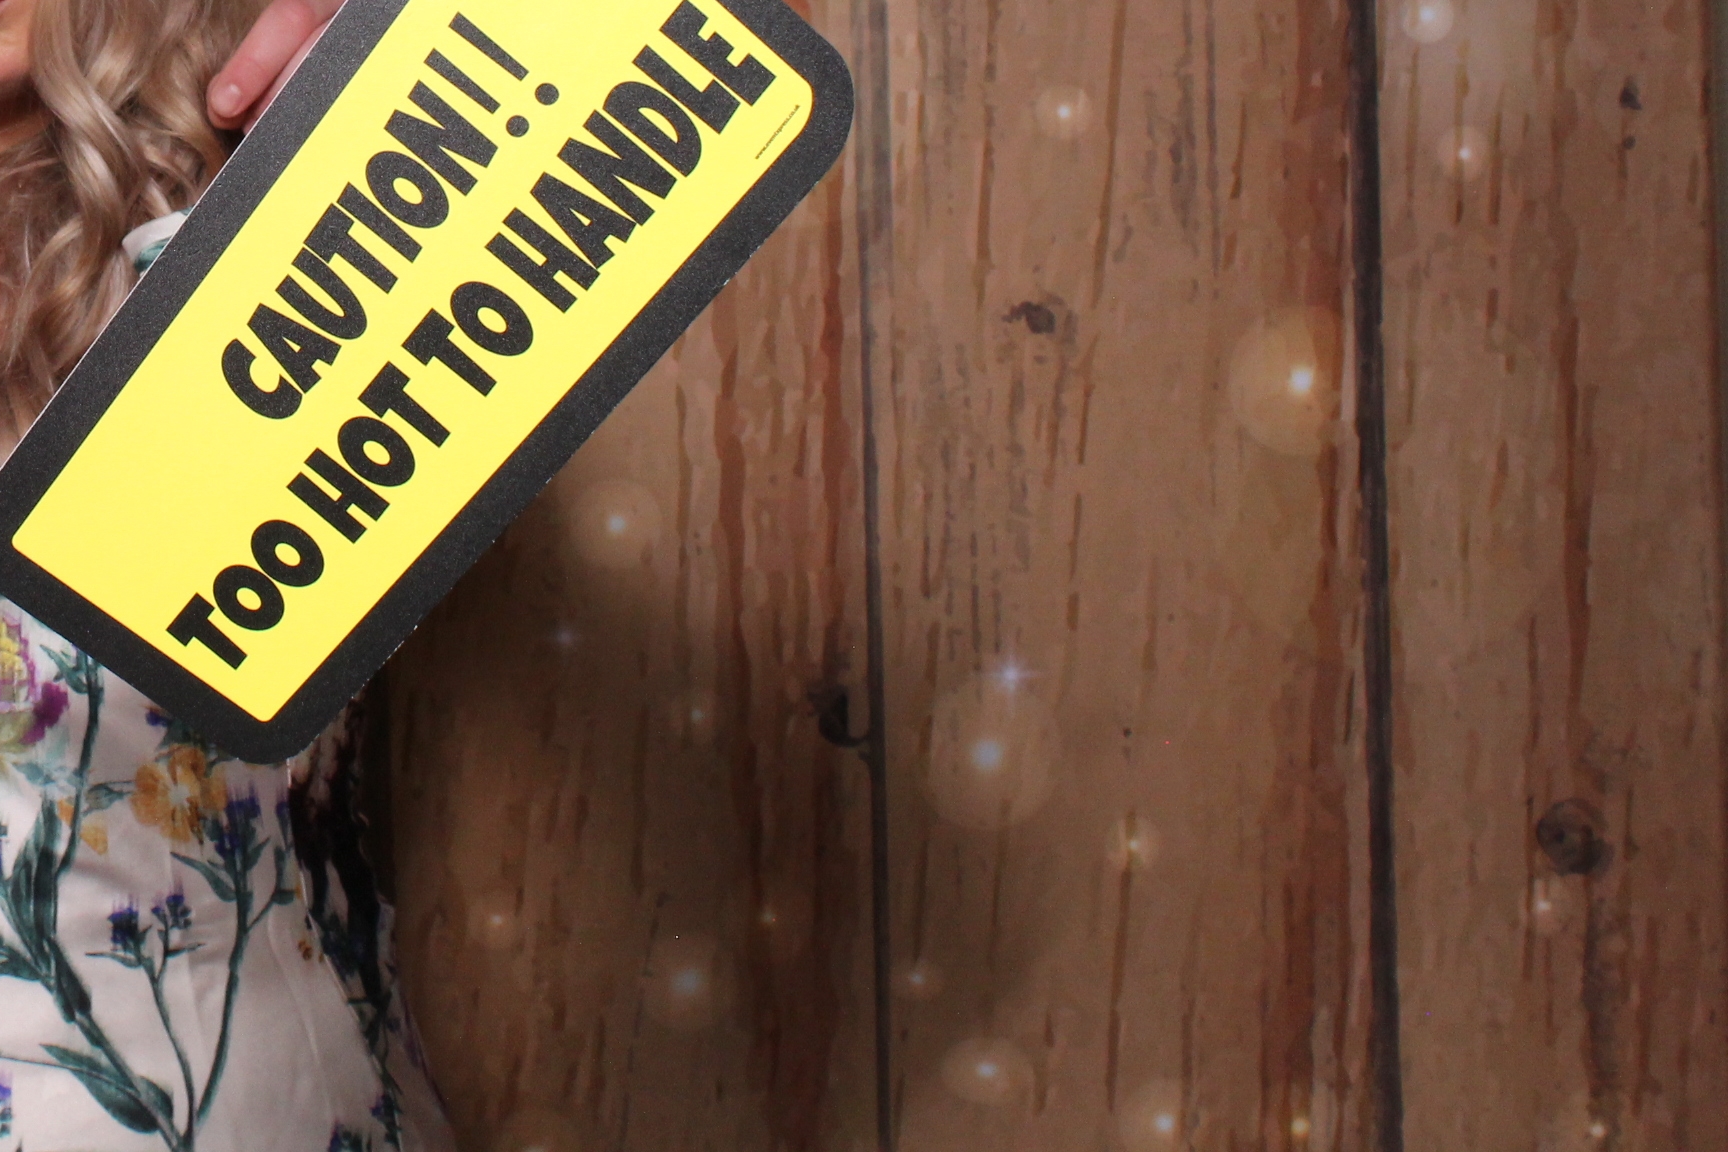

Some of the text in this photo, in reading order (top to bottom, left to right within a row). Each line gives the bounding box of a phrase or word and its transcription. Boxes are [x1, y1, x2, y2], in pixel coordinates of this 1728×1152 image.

[166, 0, 776, 671] TOO HOT TO HANDLE
[221, 13, 560, 420] CAUTION!!
